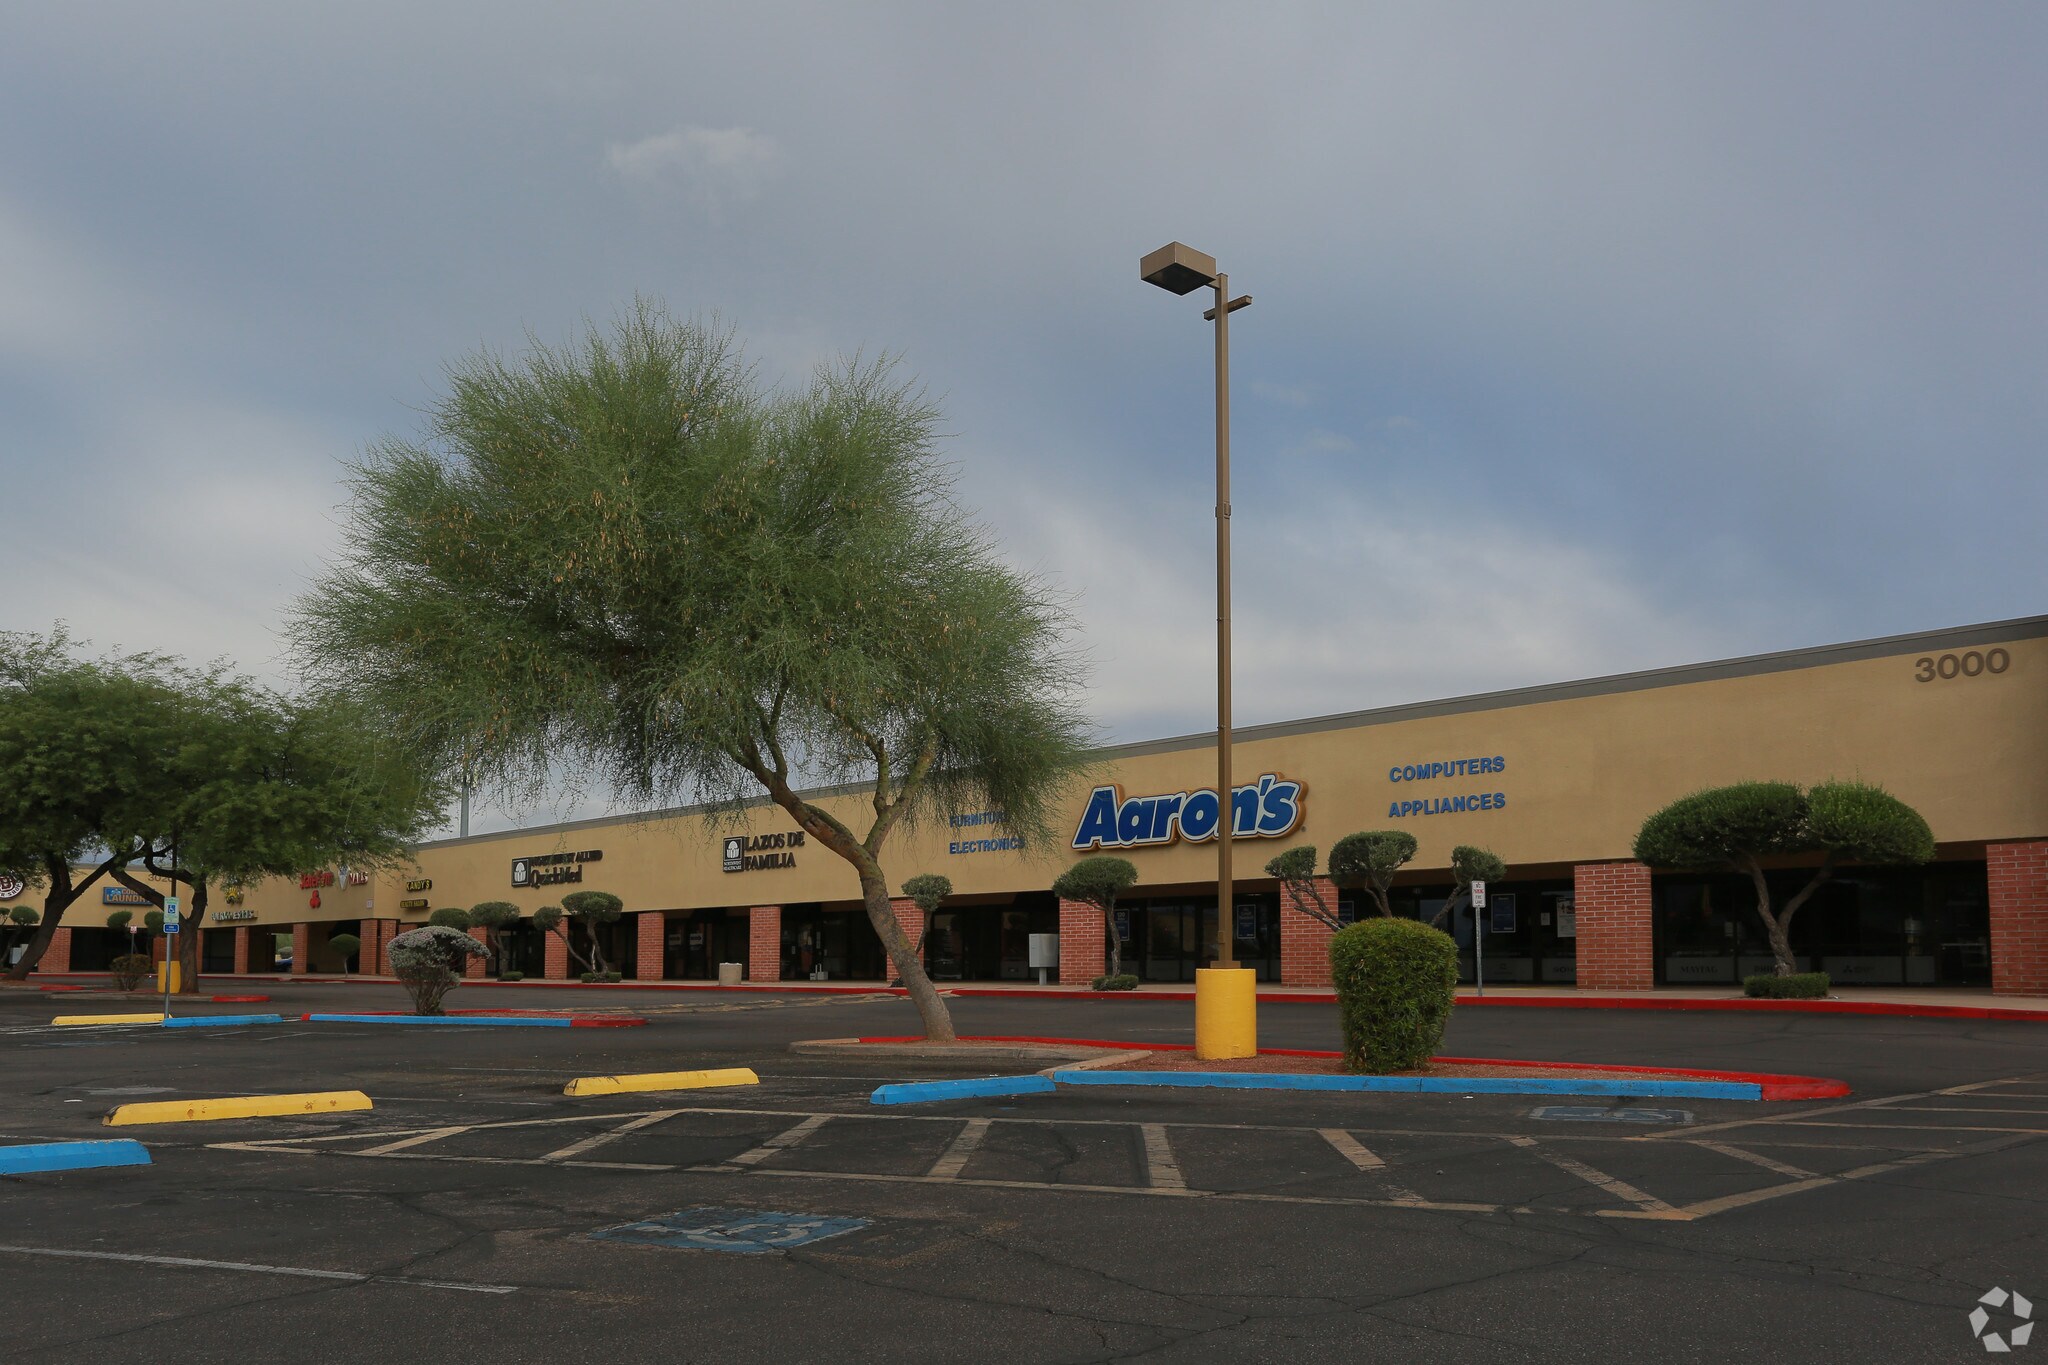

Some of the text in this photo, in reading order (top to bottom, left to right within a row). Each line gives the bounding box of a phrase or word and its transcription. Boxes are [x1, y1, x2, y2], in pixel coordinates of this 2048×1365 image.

[1915, 648, 2010, 682] 3000
[1389, 755, 1505, 783] COMPUTERS
[1071, 774, 1303, 849] Aaron's
[1388, 792, 1506, 818] APPLIANCES
[743, 830, 805, 852] LAZOS DE
[949, 836, 1025, 855] ELECTRONICS
[744, 851, 797, 872] FAMILIA
[349, 871, 369, 885] NAILS
[105, 894, 151, 903] LAUNDR
